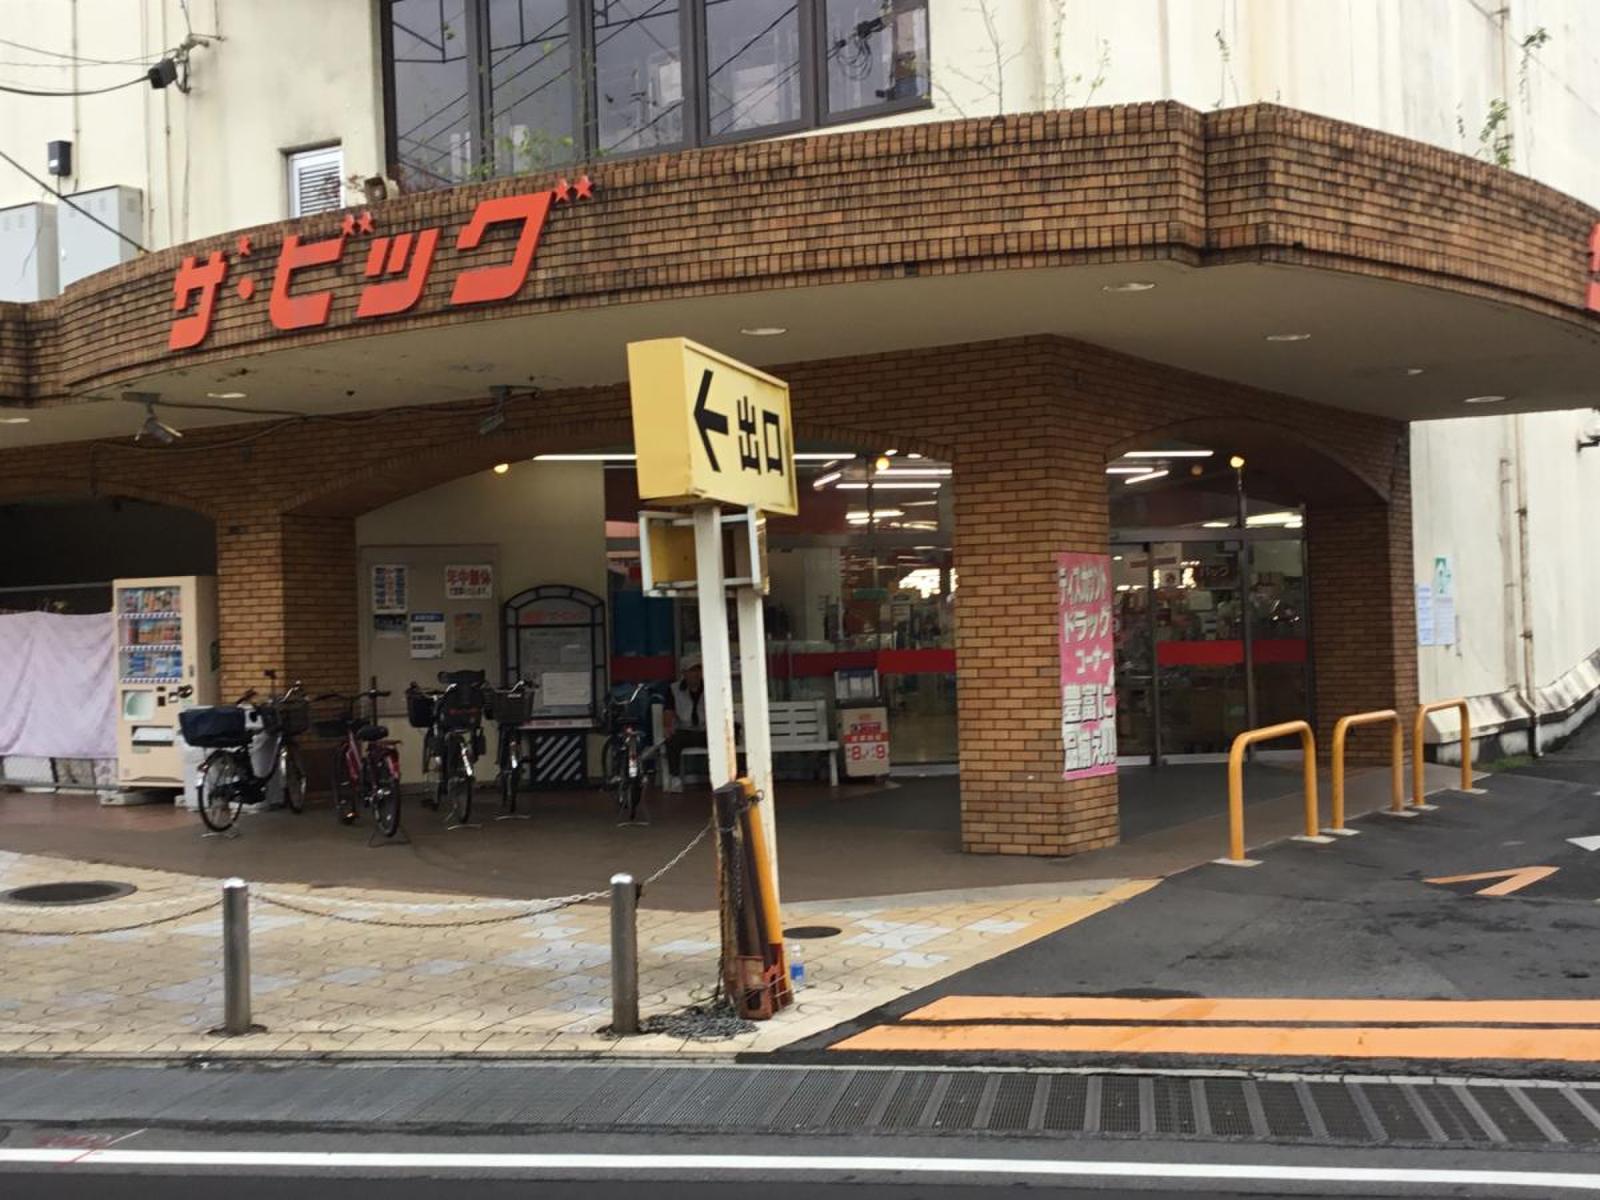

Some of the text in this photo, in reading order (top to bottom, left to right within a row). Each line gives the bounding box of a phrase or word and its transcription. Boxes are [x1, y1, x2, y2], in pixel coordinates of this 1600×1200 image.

[737, 396, 783, 476] 出口
[1064, 605, 1112, 643] ドラッグ
[1075, 645, 1112, 675] コーナー
[1063, 684, 1116, 723] 豊富に
